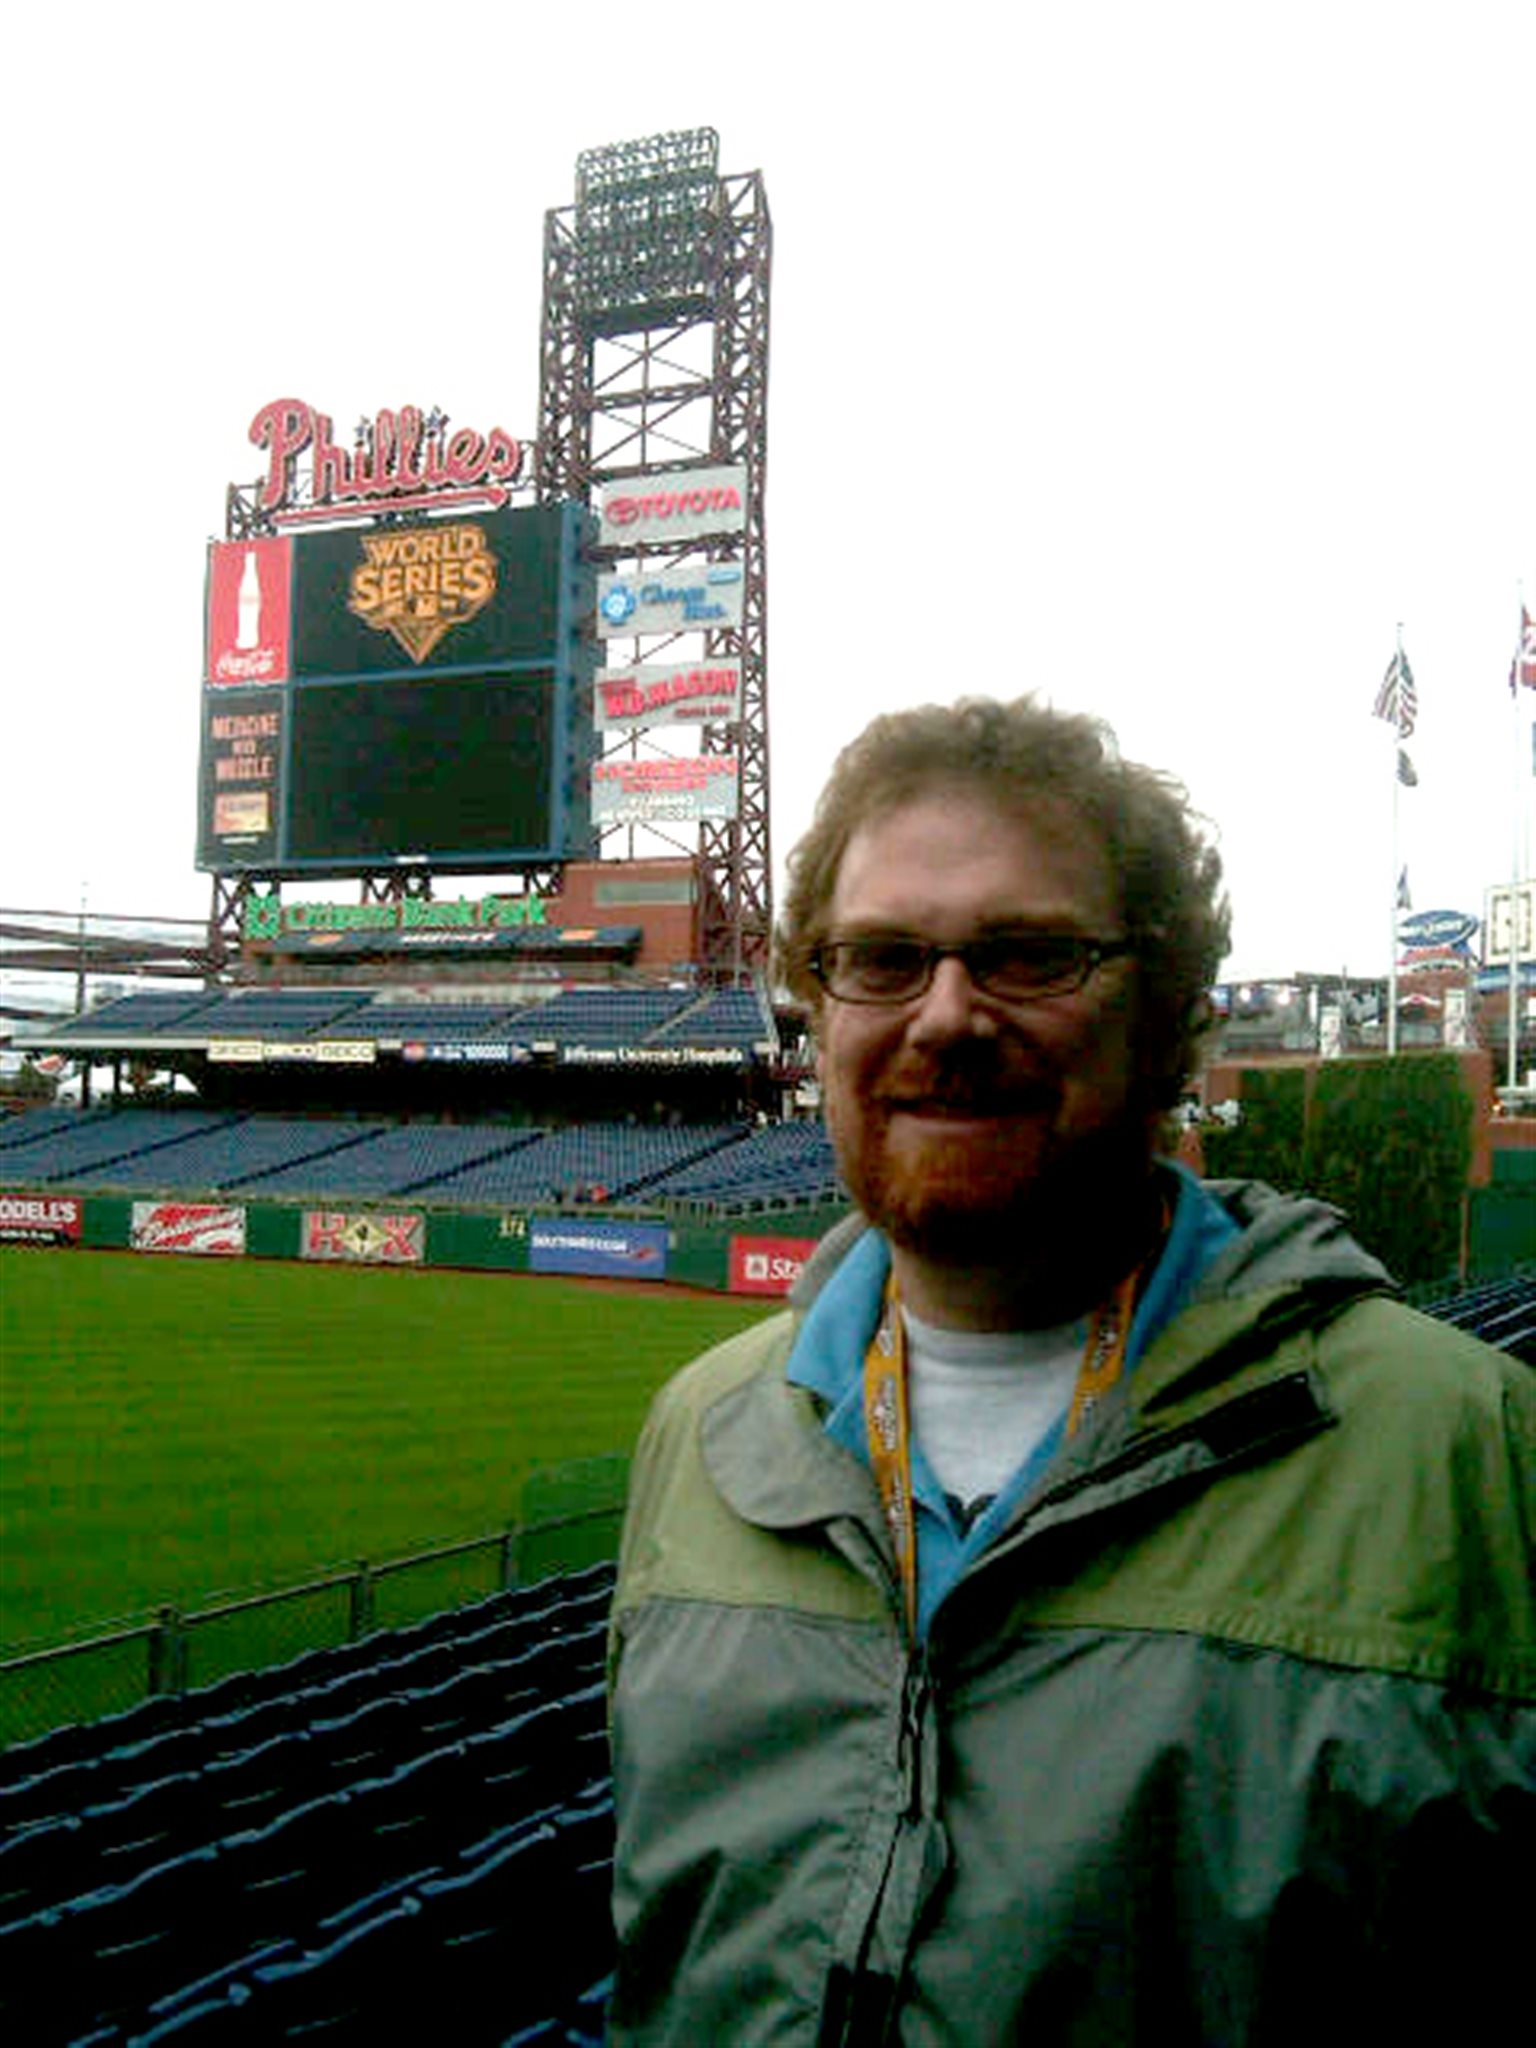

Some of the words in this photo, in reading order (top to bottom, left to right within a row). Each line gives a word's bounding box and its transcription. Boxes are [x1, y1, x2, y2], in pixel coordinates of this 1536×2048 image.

[248, 398, 520, 508] Phillies
[639, 486, 741, 520] TOYOTA
[367, 530, 480, 568] WORLD
[355, 556, 496, 611] SERIES
[402, 896, 474, 927] Bank
[480, 893, 547, 926] Park
